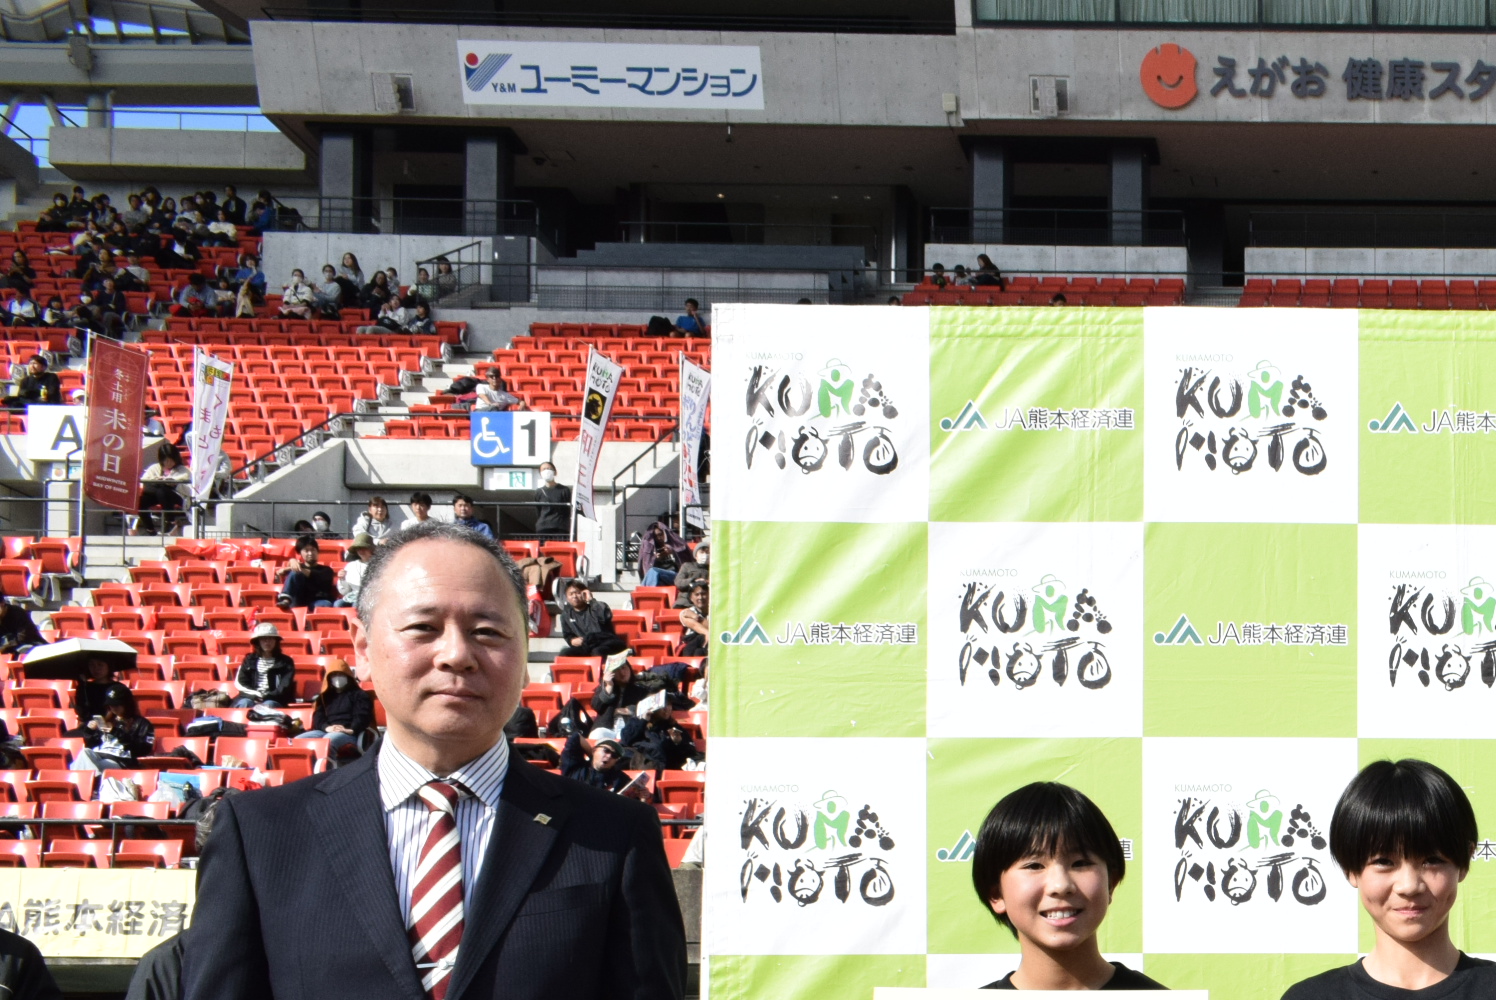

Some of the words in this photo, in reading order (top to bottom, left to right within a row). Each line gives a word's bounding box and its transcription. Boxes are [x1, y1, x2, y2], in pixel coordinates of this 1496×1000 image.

[491, 83, 517, 93] Y&M
[520, 64, 757, 97] ユーミーマンション
[1210, 56, 1329, 98] えがお
[745, 358, 898, 419] KUMA
[1175, 359, 1327, 421] KUMA
[51, 415, 83, 450] A
[521, 419, 537, 457] 1
[995, 408, 1134, 430] JA熊本経済連
[745, 421, 898, 475] MOTO
[1175, 422, 1327, 476] MOTO
[959, 575, 1112, 636] KUMA
[777, 621, 918, 645] JA熊本経済連
[1208, 622, 1348, 645] JA熊本経済連
[959, 636, 1112, 690] MOTO
[740, 790, 895, 851] KUMA
[1174, 789, 1327, 851] KUMA
[740, 852, 895, 906] MOTO
[1174, 852, 1327, 906] MOTO
[0, 898, 188, 937] A熊本経済
